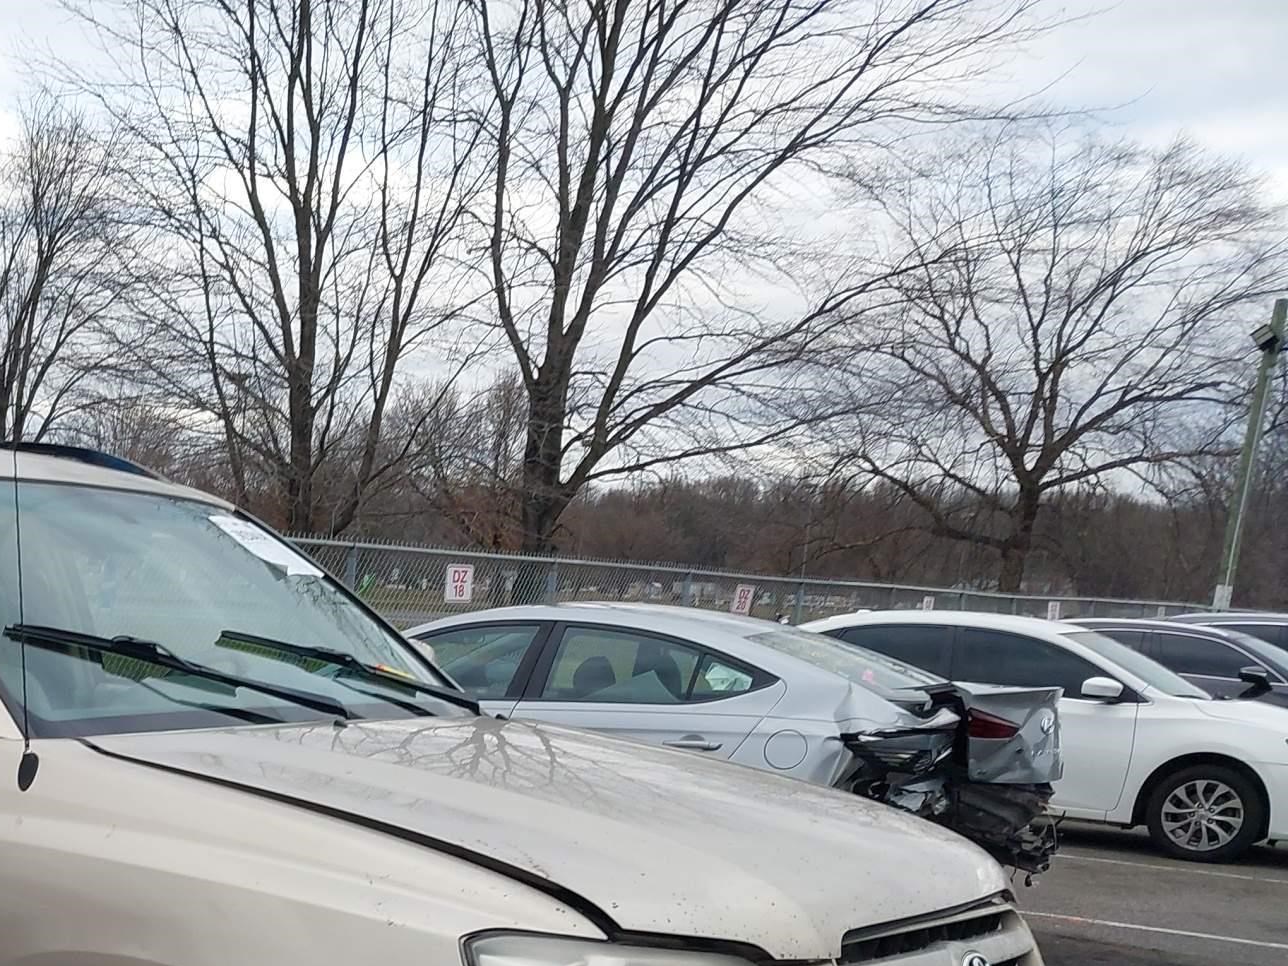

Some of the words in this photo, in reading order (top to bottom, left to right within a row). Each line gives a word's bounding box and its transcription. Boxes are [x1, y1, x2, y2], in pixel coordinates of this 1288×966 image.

[452, 570, 468, 583] DZ
[453, 584, 465, 597] 18
[738, 589, 750, 600] DZ
[736, 601, 746, 610] 20
